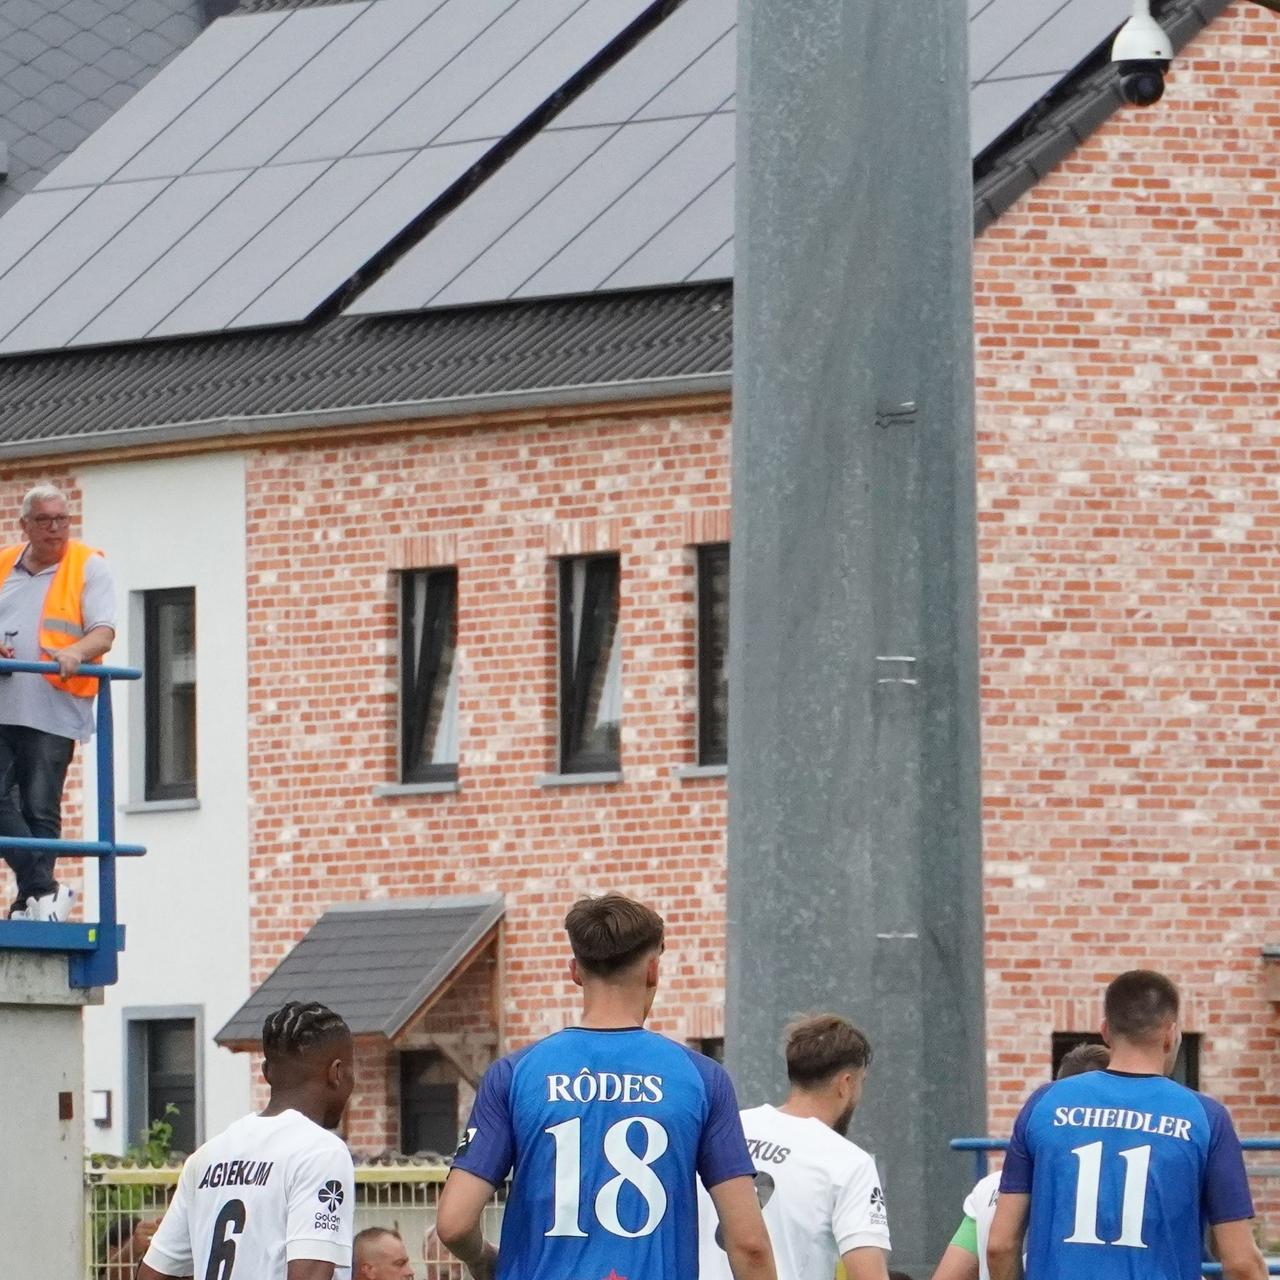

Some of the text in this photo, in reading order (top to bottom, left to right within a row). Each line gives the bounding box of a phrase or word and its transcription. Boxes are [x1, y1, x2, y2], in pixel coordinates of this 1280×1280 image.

[547, 1067, 663, 1102] RÔDES
[1054, 1107, 1192, 1141] SCHEIDLER
[746, 1139, 791, 1164] TKUS
[199, 1160, 274, 1189] AGYEKUM
[544, 1116, 669, 1238] 18
[1064, 1141, 1152, 1249] 11
